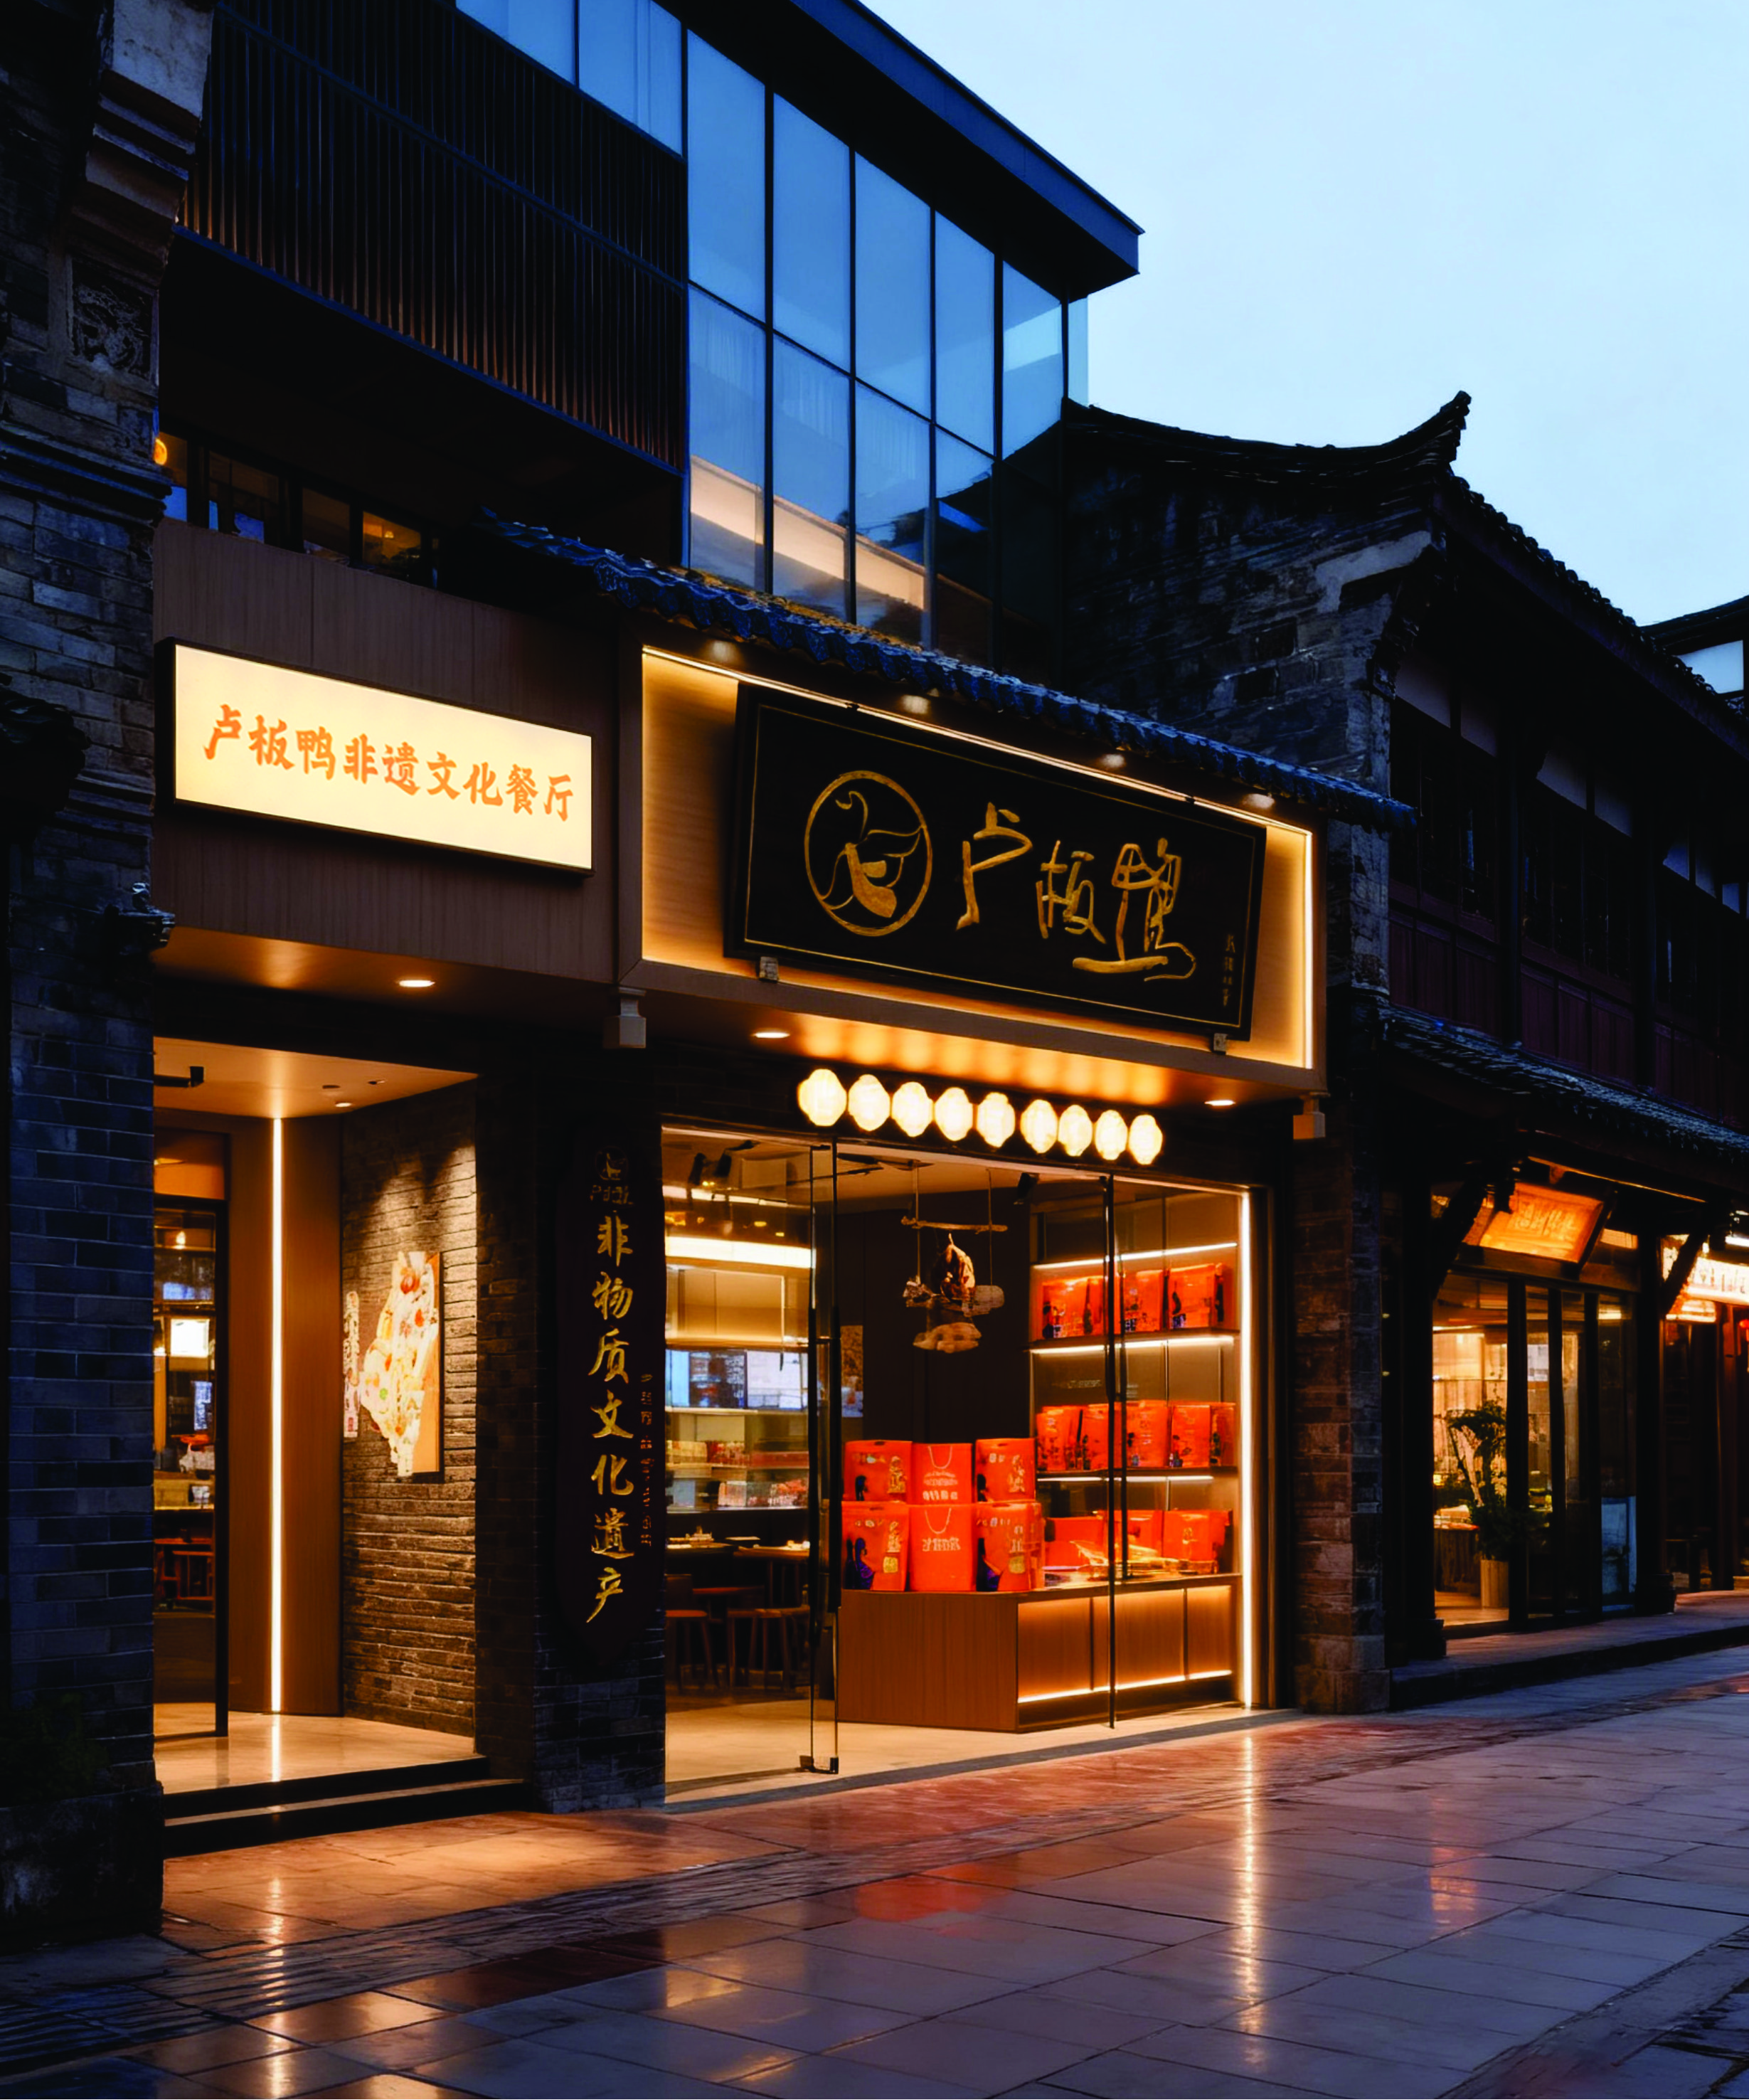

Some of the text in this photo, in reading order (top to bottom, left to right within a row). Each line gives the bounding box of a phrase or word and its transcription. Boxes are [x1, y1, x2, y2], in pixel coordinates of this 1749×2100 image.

[203, 704, 574, 822] 卢板鸭非遗文化餐厅
